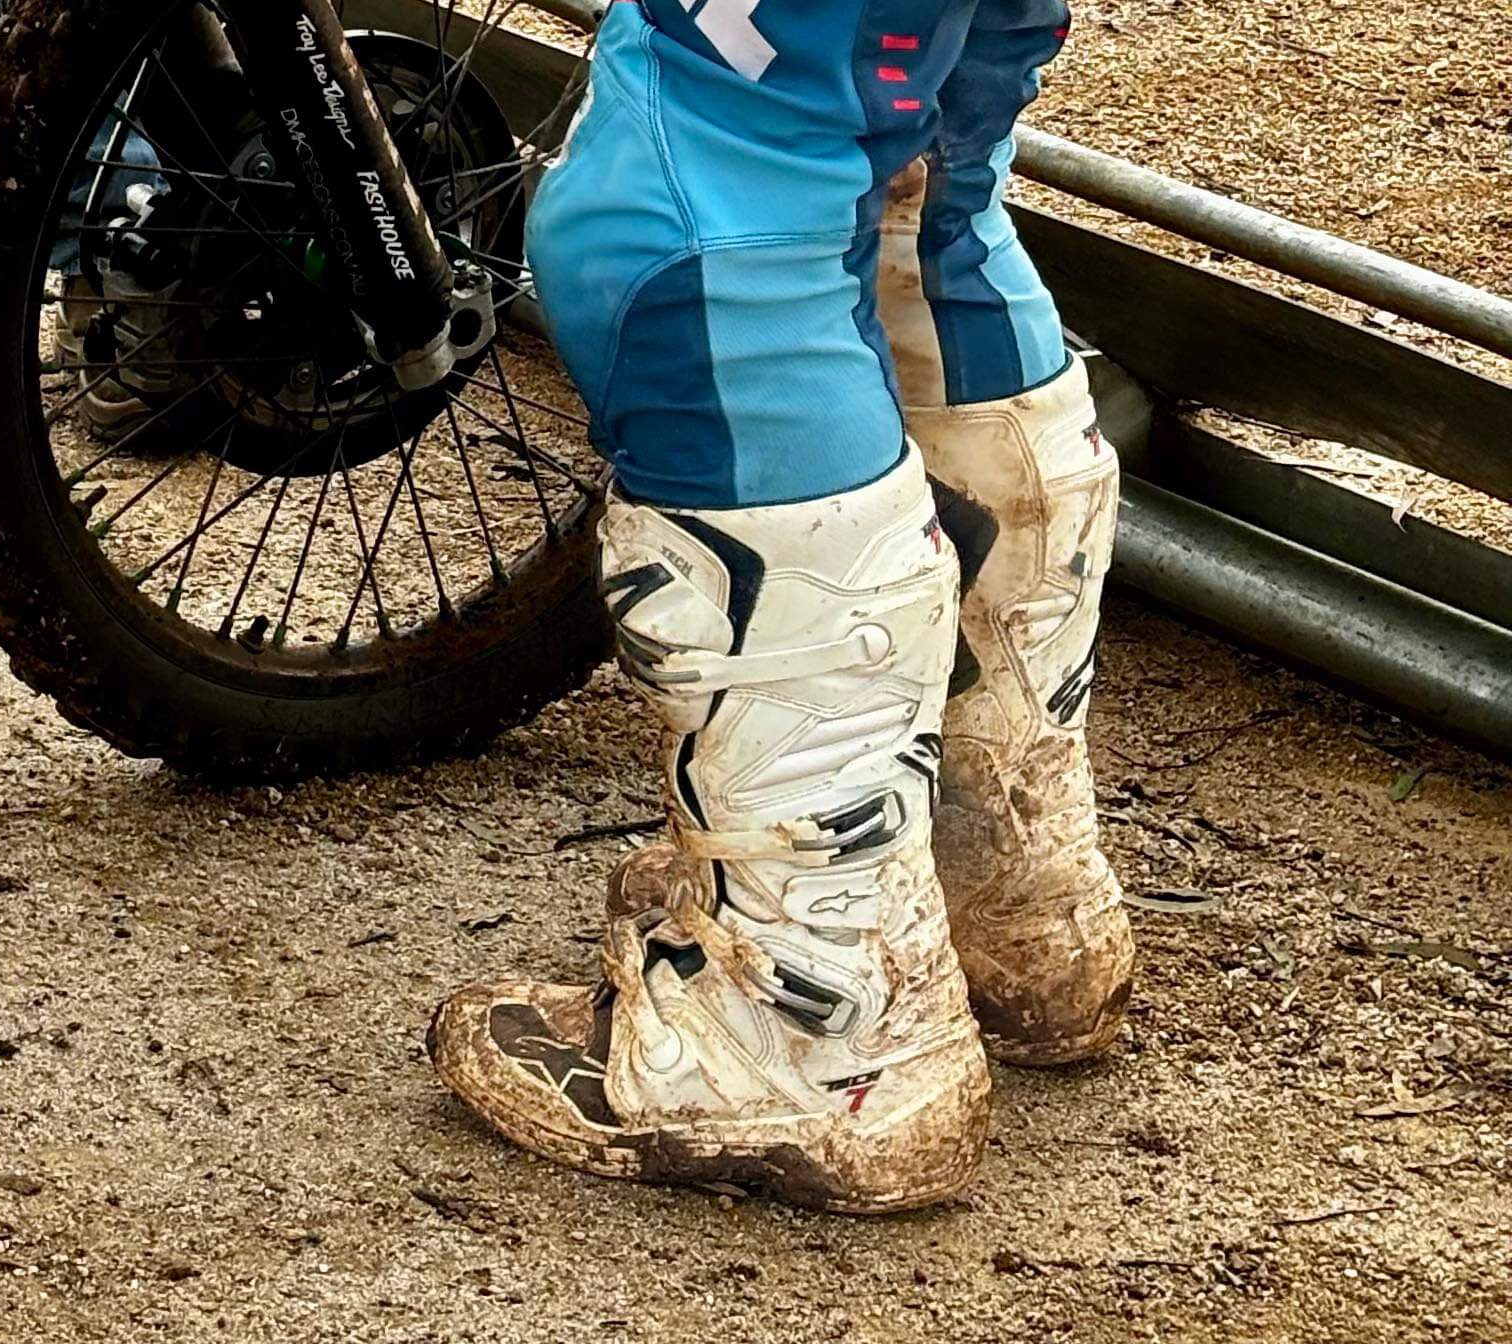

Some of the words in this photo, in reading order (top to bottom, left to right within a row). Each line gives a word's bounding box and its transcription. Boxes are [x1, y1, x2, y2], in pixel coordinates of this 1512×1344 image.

[295, 14, 317, 53] Troy
[308, 53, 328, 85] Lee
[356, 170, 416, 281] FASTHOUSE
[844, 1083, 878, 1114] 7
